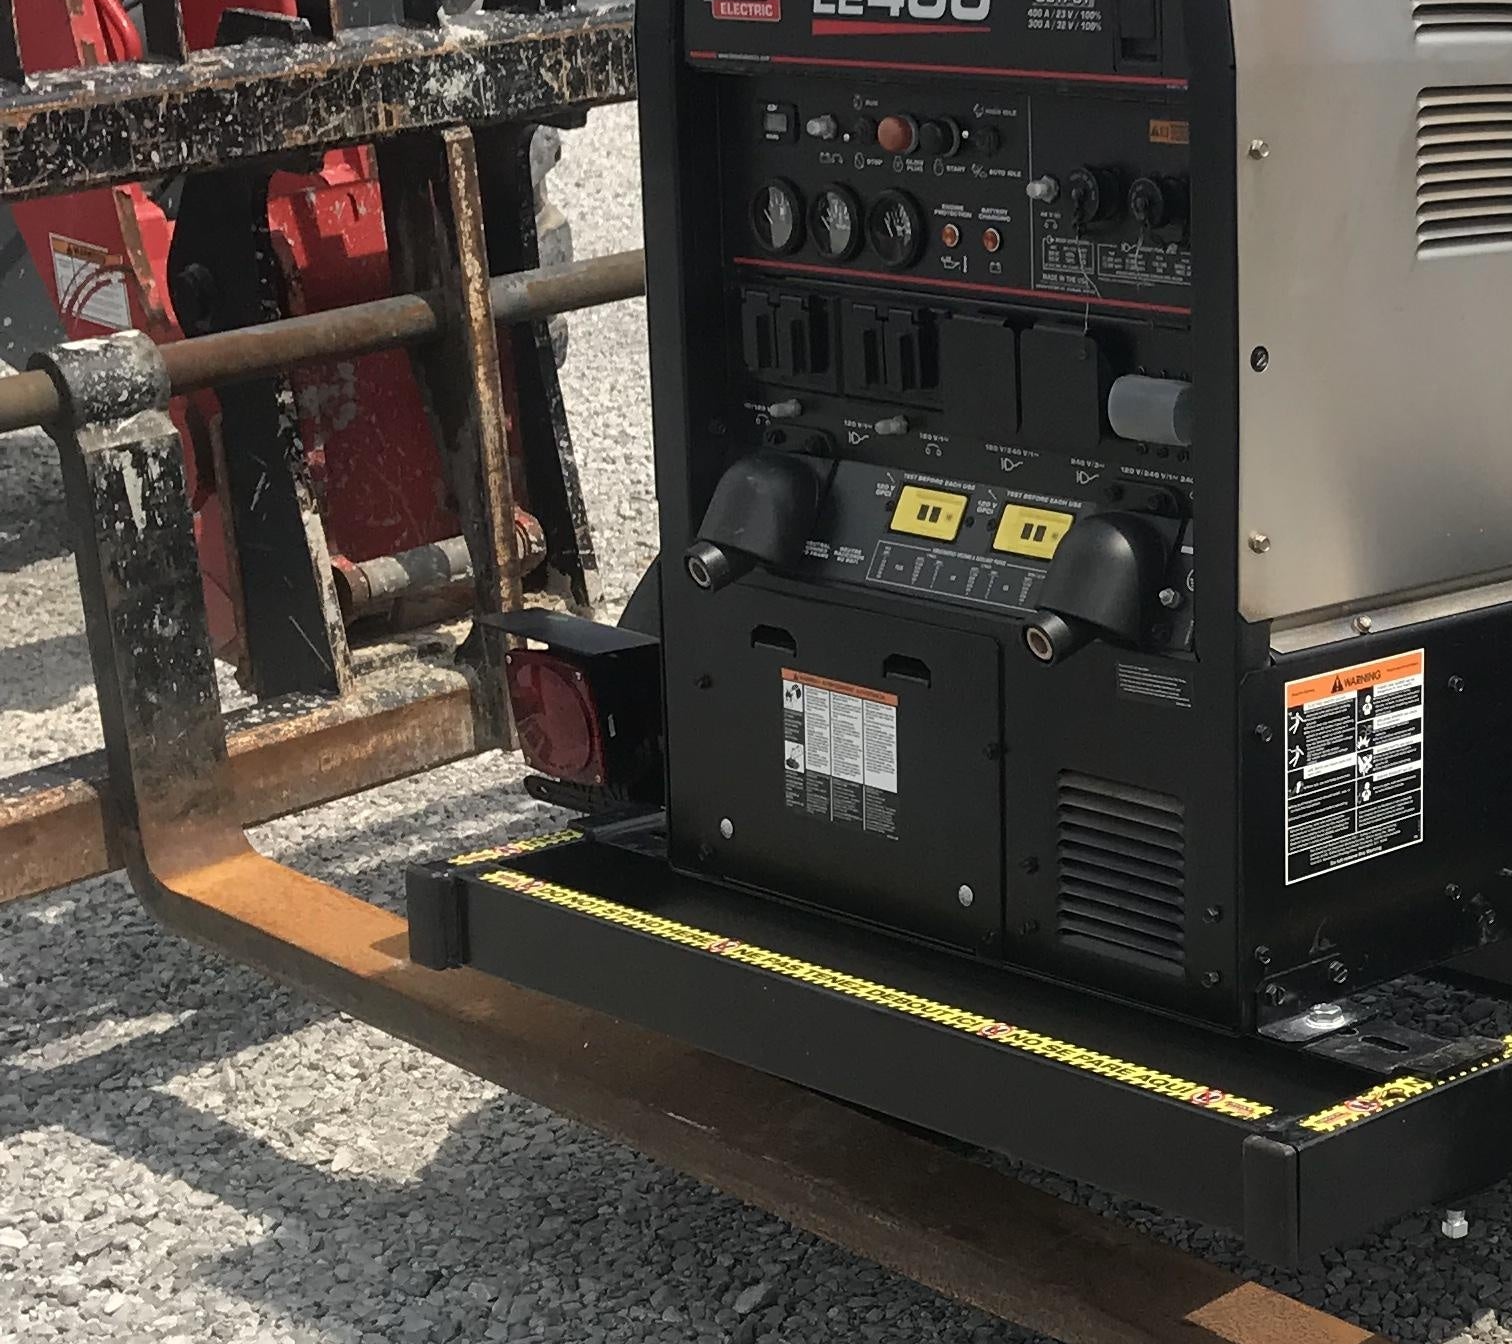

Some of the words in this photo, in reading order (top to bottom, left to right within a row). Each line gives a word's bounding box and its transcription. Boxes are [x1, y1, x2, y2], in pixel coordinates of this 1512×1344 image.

[720, 2, 774, 17] ELECTRIC
[1343, 669, 1382, 687] WARNING
[732, 946, 762, 962] NE
[763, 957, 806, 973] PAS
[802, 969, 872, 993] TENEZ
[867, 989, 950, 1019] DEBOUT
[949, 1015, 980, 1027] ICI
[1007, 1033, 1042, 1047] NO
[1042, 1043, 1077, 1057] SE
[1072, 1054, 1137, 1076] PARE
[1132, 1074, 1195, 1094] AQUI
